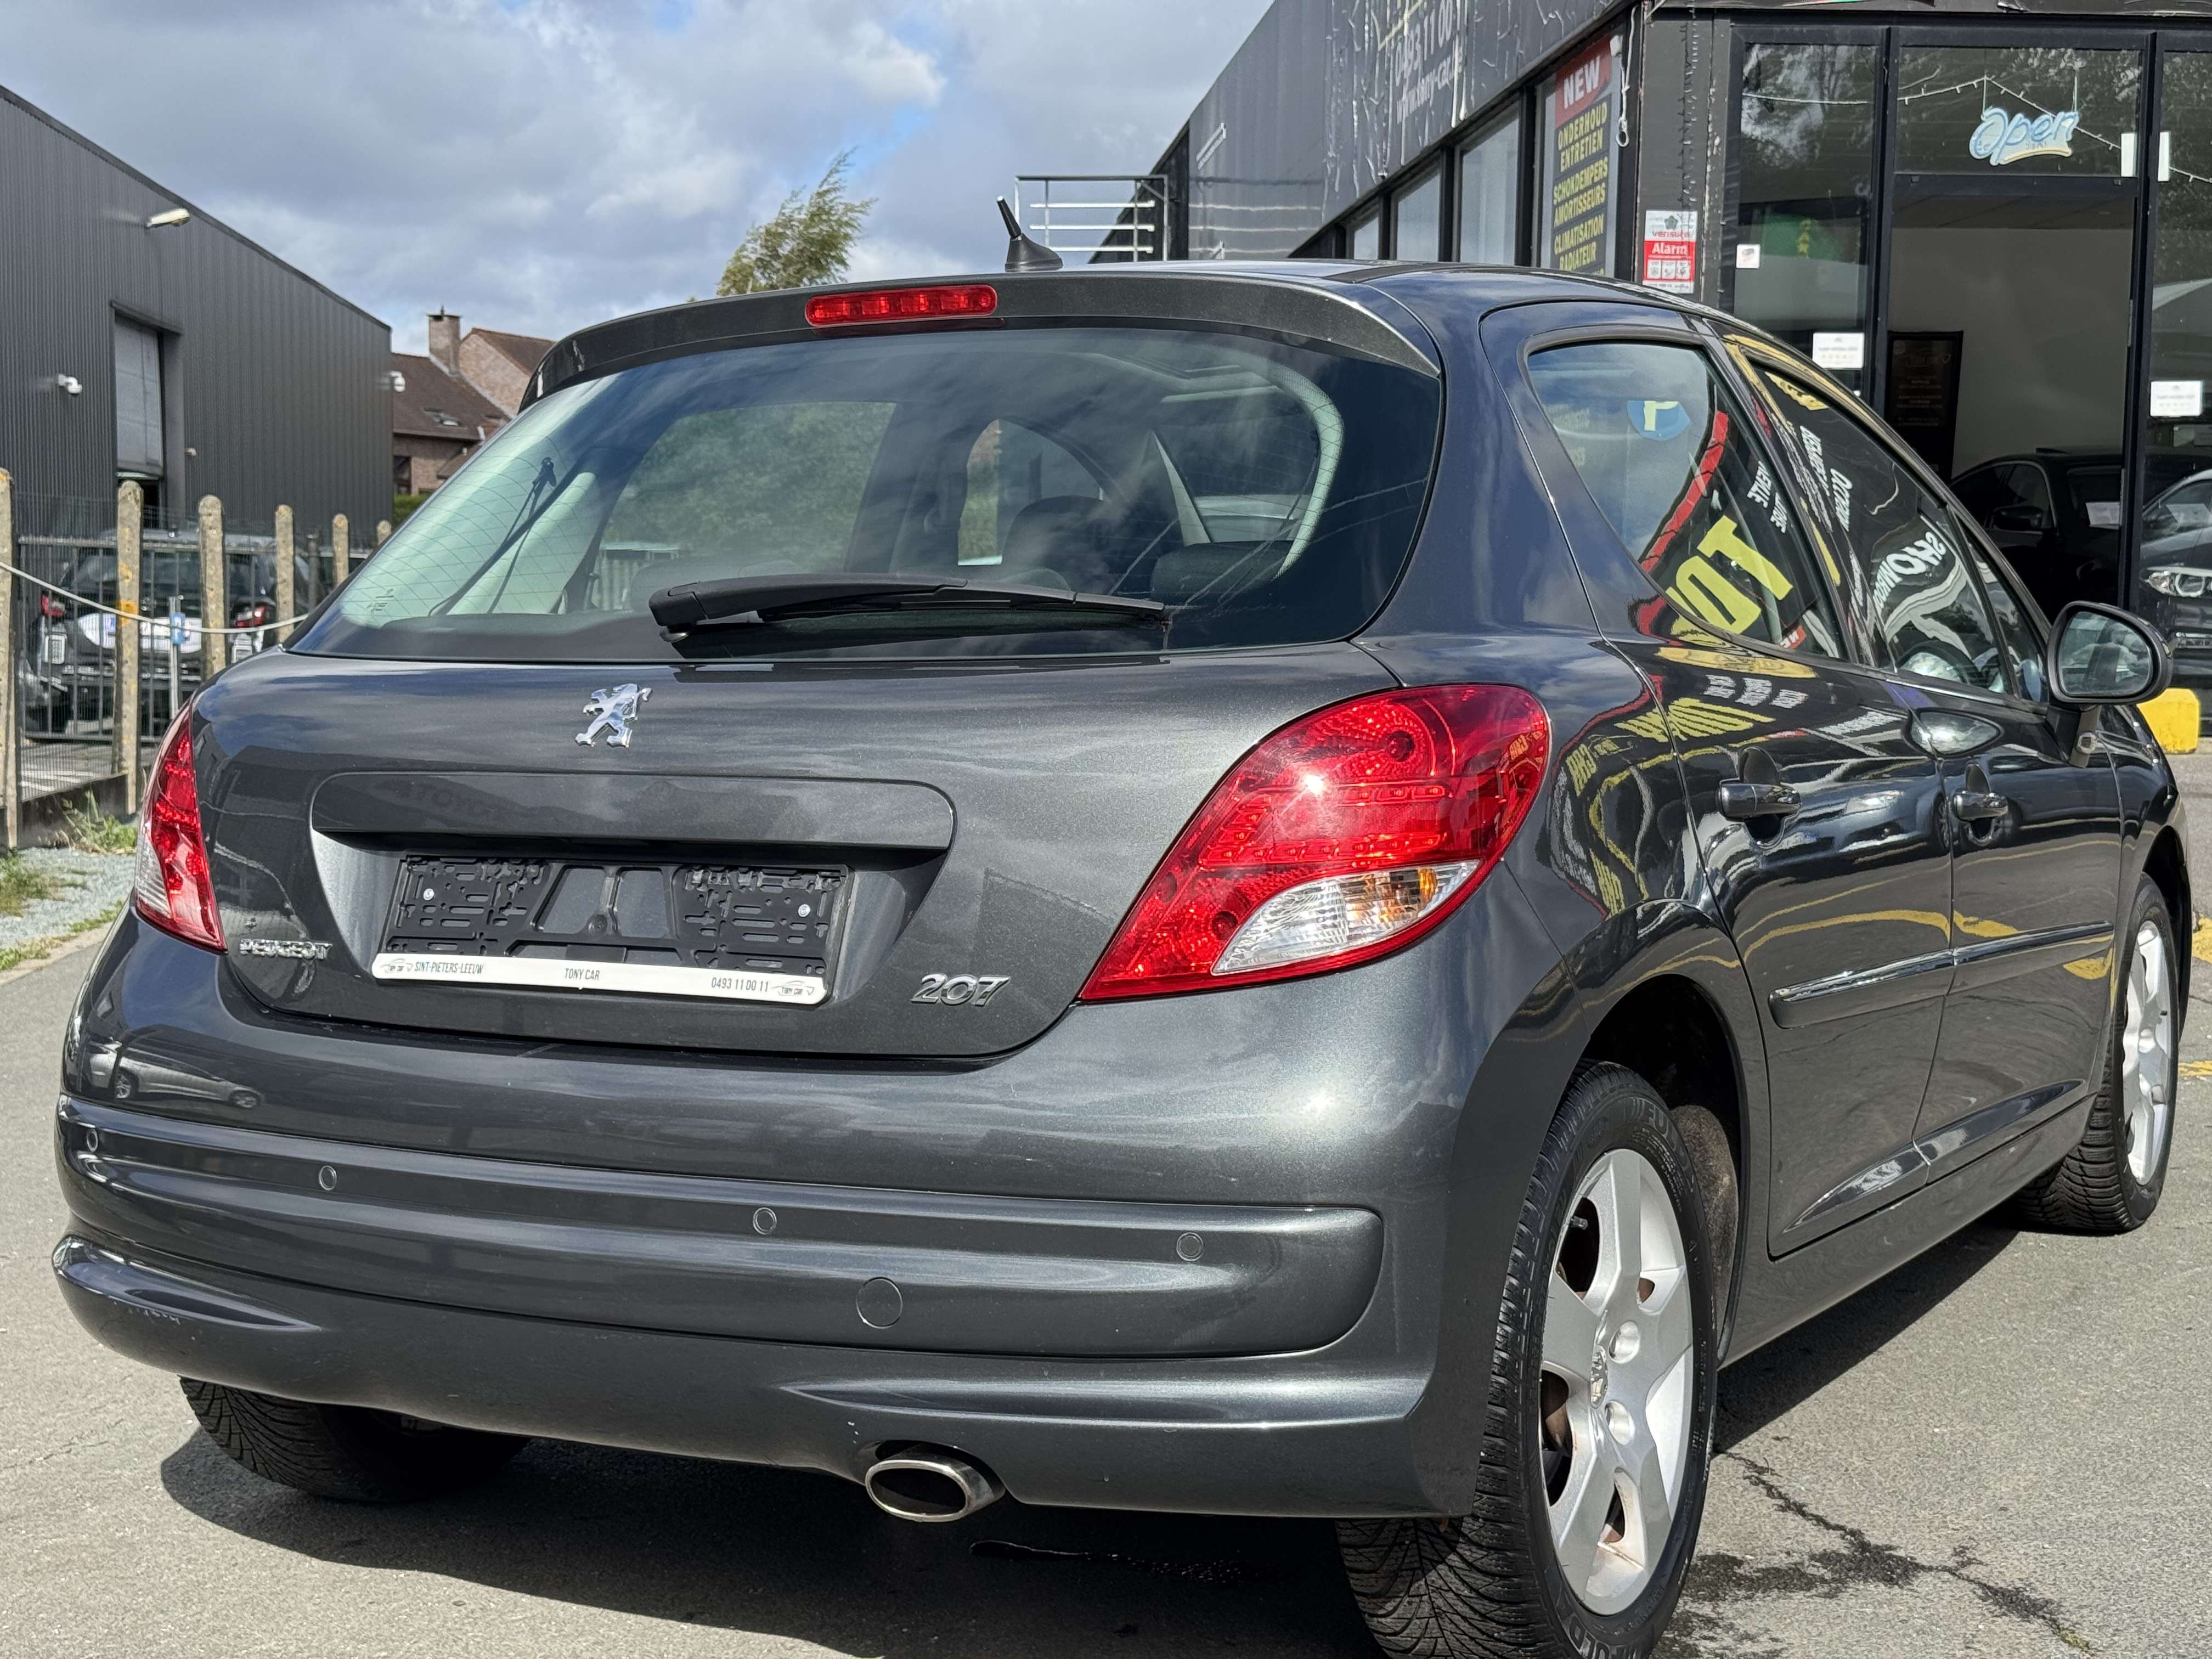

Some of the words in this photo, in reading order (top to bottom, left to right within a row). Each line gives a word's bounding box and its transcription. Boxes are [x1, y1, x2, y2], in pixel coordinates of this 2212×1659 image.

[1564, 55, 1600, 109] NEW
[1558, 101, 1607, 151] ONDERHOUD
[1970, 108, 2079, 165] Open
[1560, 127, 1604, 173] ENTRETIEN
[1554, 156, 1609, 205] SCHOKDEMPERS
[1554, 182, 1605, 228] AMORTISSEURS
[1554, 213, 1604, 255] CLIMATISATION
[1651, 242, 1689, 255] Alarm
[1559, 241, 1596, 271] RADIATEUR
[239, 938, 333, 960] PEUGEOT
[414, 961, 483, 974] SINT-PIETERS-LEEUW
[565, 968, 584, 980] TONY
[585, 969, 600, 981] CAR
[711, 977, 732, 990] 0493
[735, 978, 744, 990] 11
[746, 979, 757, 991] 00
[760, 980, 769, 992] 11
[910, 973, 1011, 1007] 207
